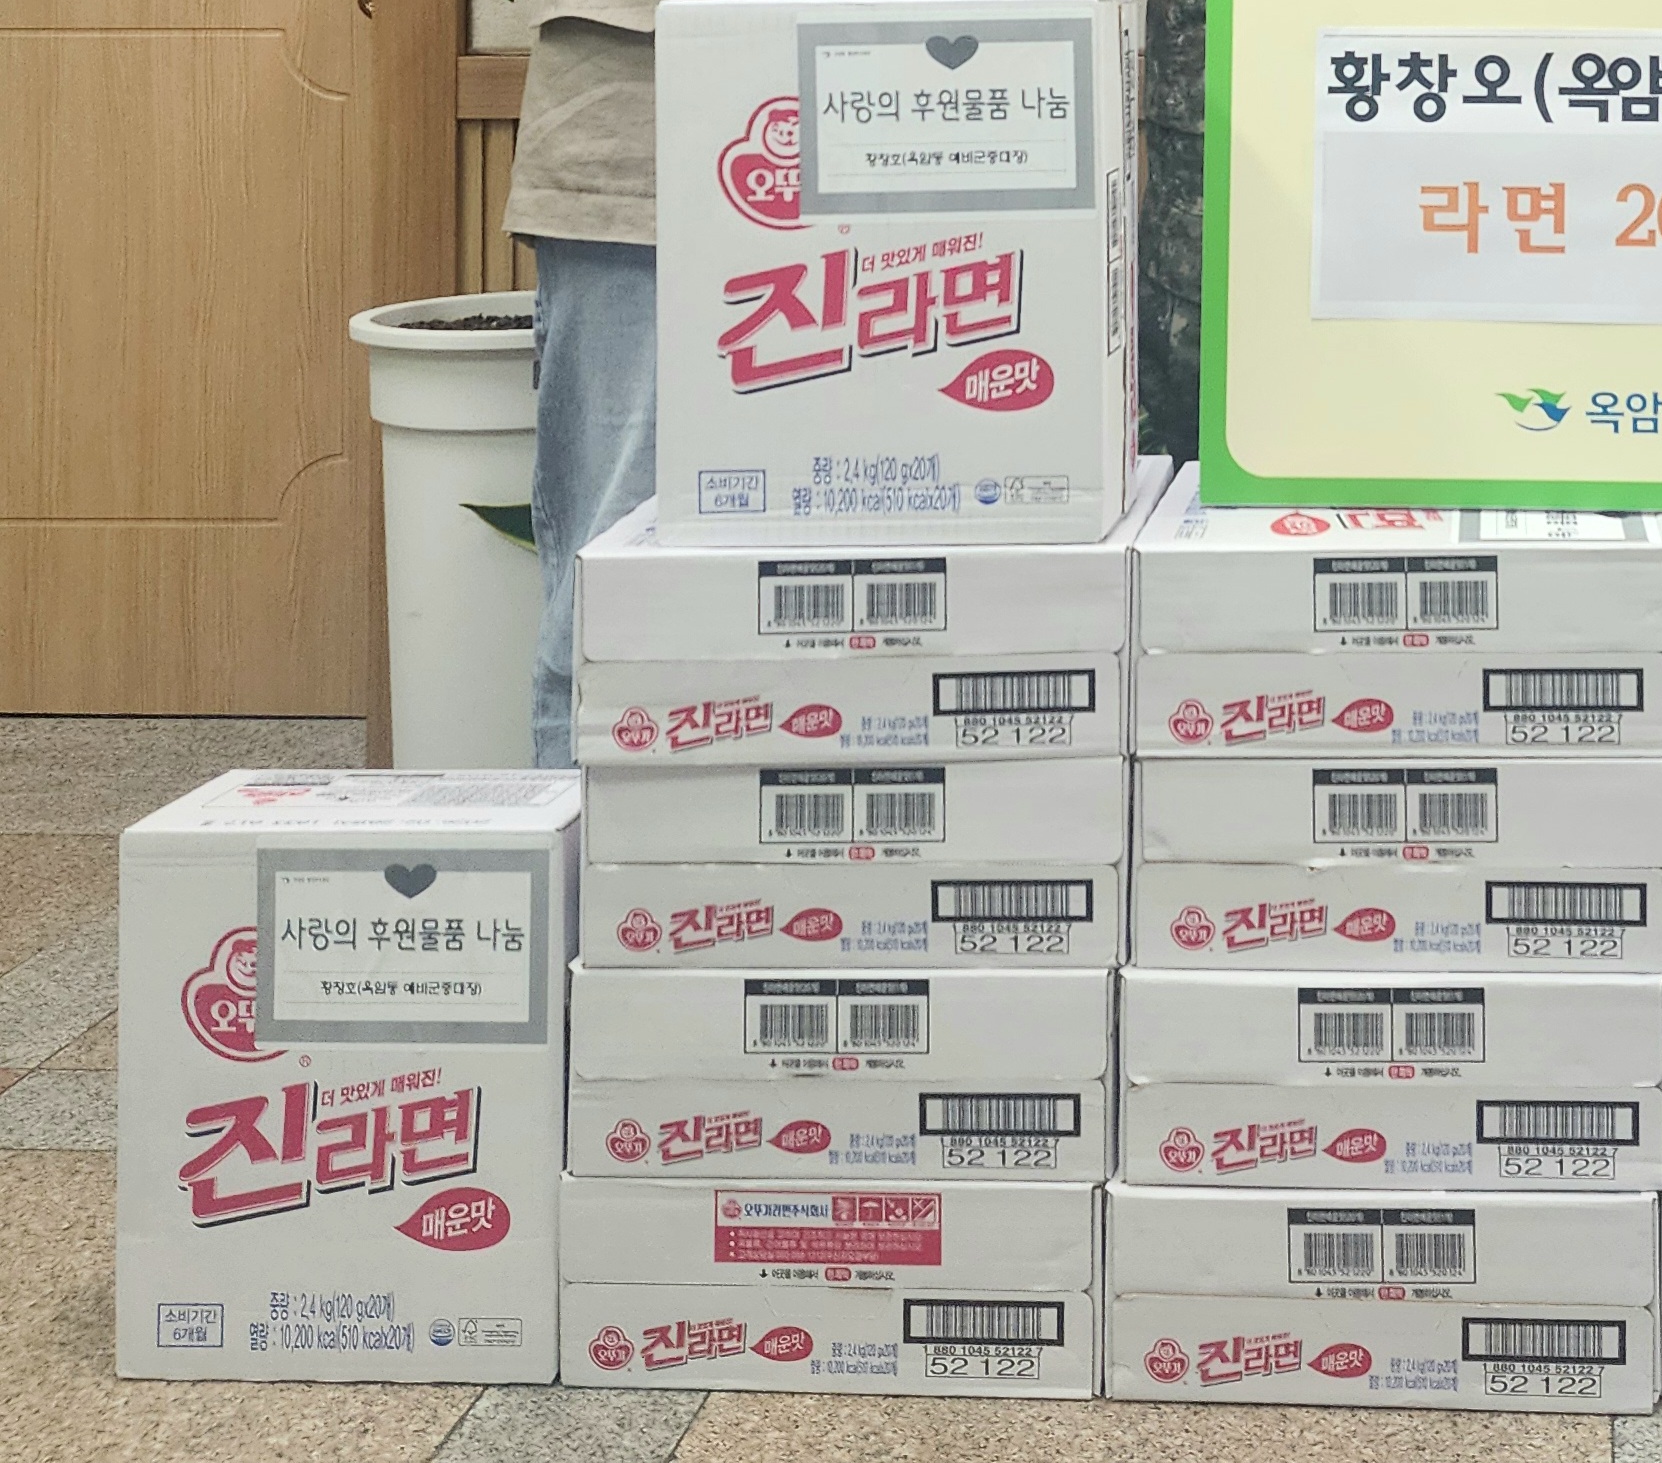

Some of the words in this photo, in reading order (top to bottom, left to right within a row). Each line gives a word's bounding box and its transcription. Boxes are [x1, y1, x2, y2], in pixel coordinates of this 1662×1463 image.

[823, 88, 900, 123] 사랑의
[912, 89, 1011, 123] 후원물품
[1020, 88, 1069, 120] 나눔
[1419, 181, 1568, 258] 라면
[862, 255, 875, 273] 더
[880, 245, 929, 269] 맛있게
[932, 233, 983, 261] 매워진!
[717, 246, 1023, 395] 진라면
[965, 359, 1040, 402] 매운맛
[705, 476, 759, 491] 소비기간
[812, 457, 833, 484] 중량
[714, 493, 750, 509] 6개월
[823, 489, 858, 515] 10,200
[667, 694, 773, 753] 진라면
[1221, 689, 1325, 745] 진라면
[1511, 723, 1550, 743] 52
[1565, 723, 1617, 743] 122
[961, 725, 1000, 746] 52
[1015, 725, 1067, 746] 122
[281, 917, 358, 952] 사랑의
[367, 918, 466, 952] 후원물품
[476, 917, 525, 952] 나눔
[668, 900, 774, 955] 진라면
[959, 932, 1000, 953] 52
[1014, 932, 1065, 953] 122
[1222, 898, 1328, 952] 진라면
[1513, 937, 1552, 957] 52
[1566, 937, 1618, 957] 122
[321, 1091, 334, 1108] 더
[340, 1081, 386, 1104] 맛있게
[390, 1068, 442, 1097] 매워진!
[178, 1080, 481, 1228] 진라면
[657, 1111, 763, 1165] 진라면
[1212, 1118, 1317, 1175] 진라면
[1334, 1134, 1378, 1157] 매운맛
[947, 1148, 986, 1168] 52
[996, 1148, 1053, 1168] 122
[421, 1197, 496, 1240] 매운맛
[164, 1308, 217, 1324] 소비기간
[270, 1291, 293, 1320] 중량
[173, 1326, 208, 1343] 6개월
[279, 1325, 314, 1352] 10,200
[642, 1318, 748, 1371] 진라면
[763, 1332, 805, 1356] 매운맛
[1196, 1333, 1302, 1387] 진라면
[1320, 1348, 1364, 1372] 매운맛
